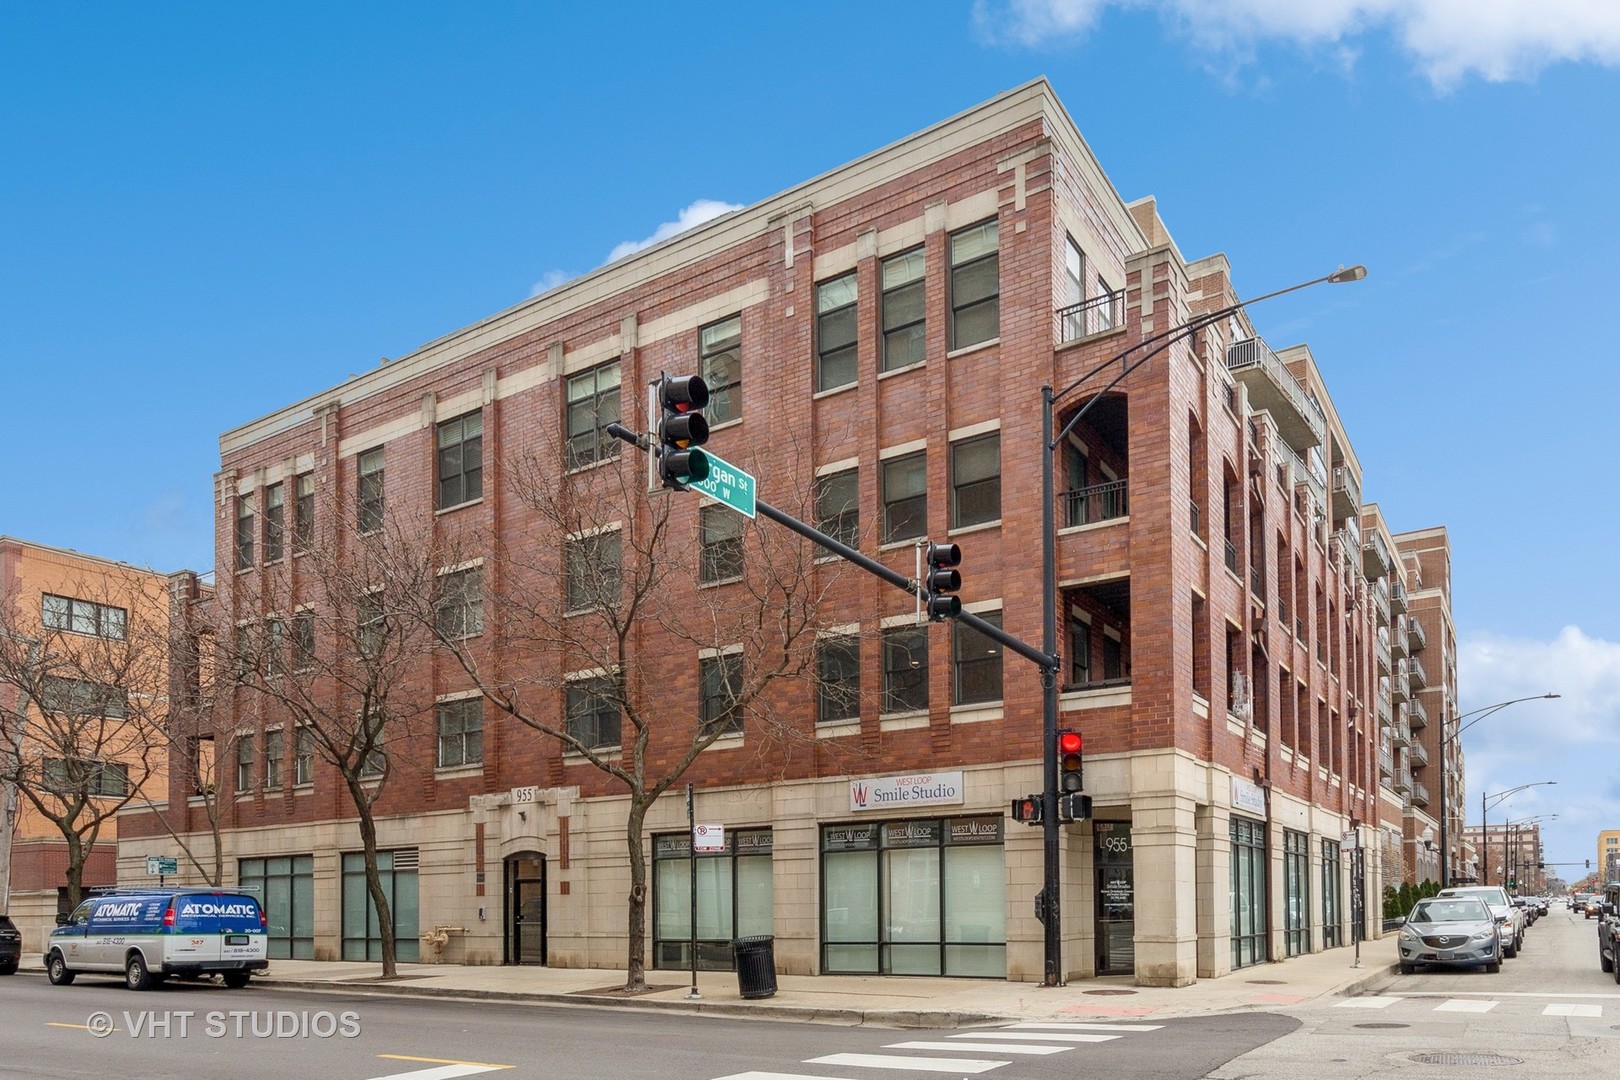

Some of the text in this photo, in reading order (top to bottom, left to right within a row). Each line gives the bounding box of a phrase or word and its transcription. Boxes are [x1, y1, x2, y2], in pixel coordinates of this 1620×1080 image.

[709, 464, 736, 488] gan
[722, 487, 731, 500] W
[896, 776, 932, 786] WEST LOOP
[516, 788, 532, 802] 955
[874, 784, 955, 803] Smile Studio
[951, 825, 968, 833] WEST
[978, 824, 998, 832] LOOP
[1105, 837, 1128, 852] 955
[94, 903, 143, 918] ATOMATIC
[182, 903, 256, 915] ATOMATIC
